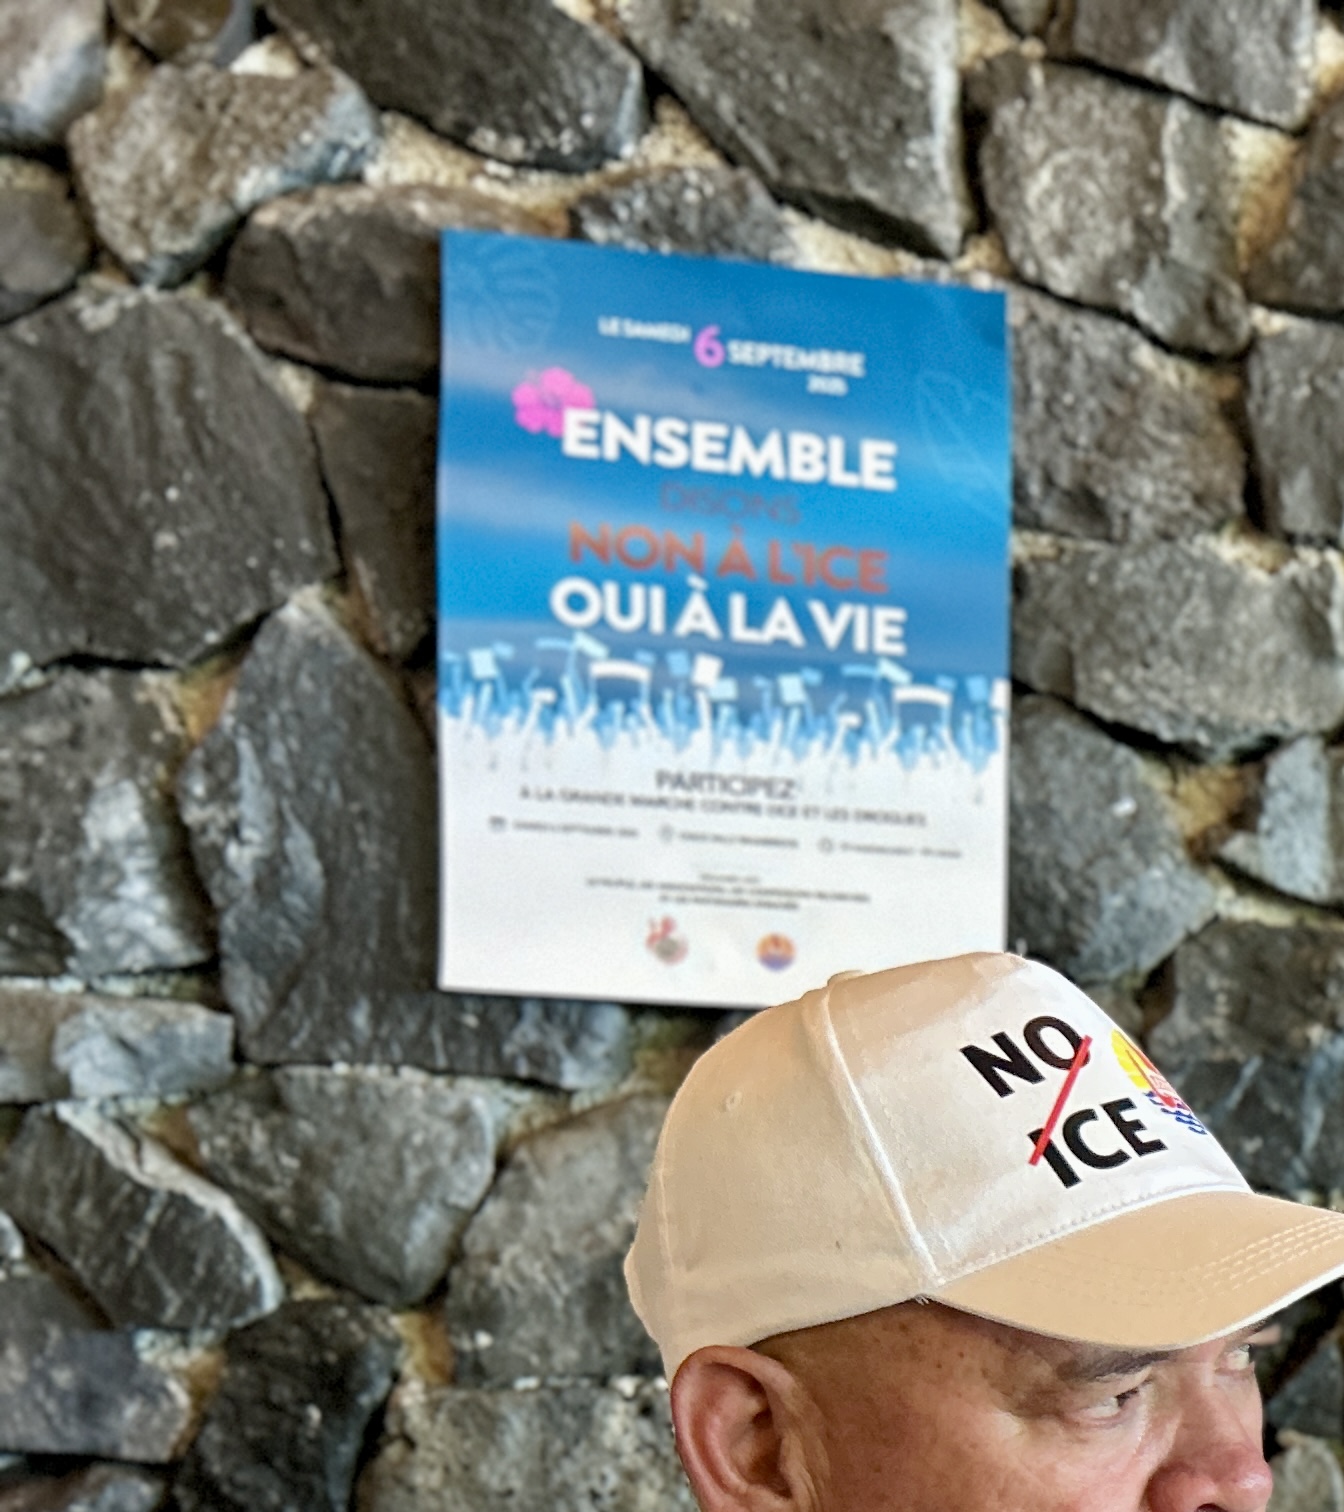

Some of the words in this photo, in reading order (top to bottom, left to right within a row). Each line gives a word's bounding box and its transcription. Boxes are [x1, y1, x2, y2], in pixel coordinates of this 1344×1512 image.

[598, 316, 621, 338] LE
[623, 318, 691, 344] SAMEDI
[694, 323, 725, 368] 6
[727, 339, 867, 378] SEPTEMBRE
[562, 408, 898, 491] ENSEMBLE
[568, 522, 705, 577] NON
[717, 525, 757, 583] À
[769, 539, 890, 594] L'ICE
[551, 575, 666, 635] OUI
[673, 574, 724, 640] À
[730, 592, 806, 648] LA
[807, 599, 908, 657] VIE
[655, 769, 798, 800] PARTICIPEZ
[959, 1015, 1091, 1098] NO
[1026, 1097, 1169, 1189] ICE
